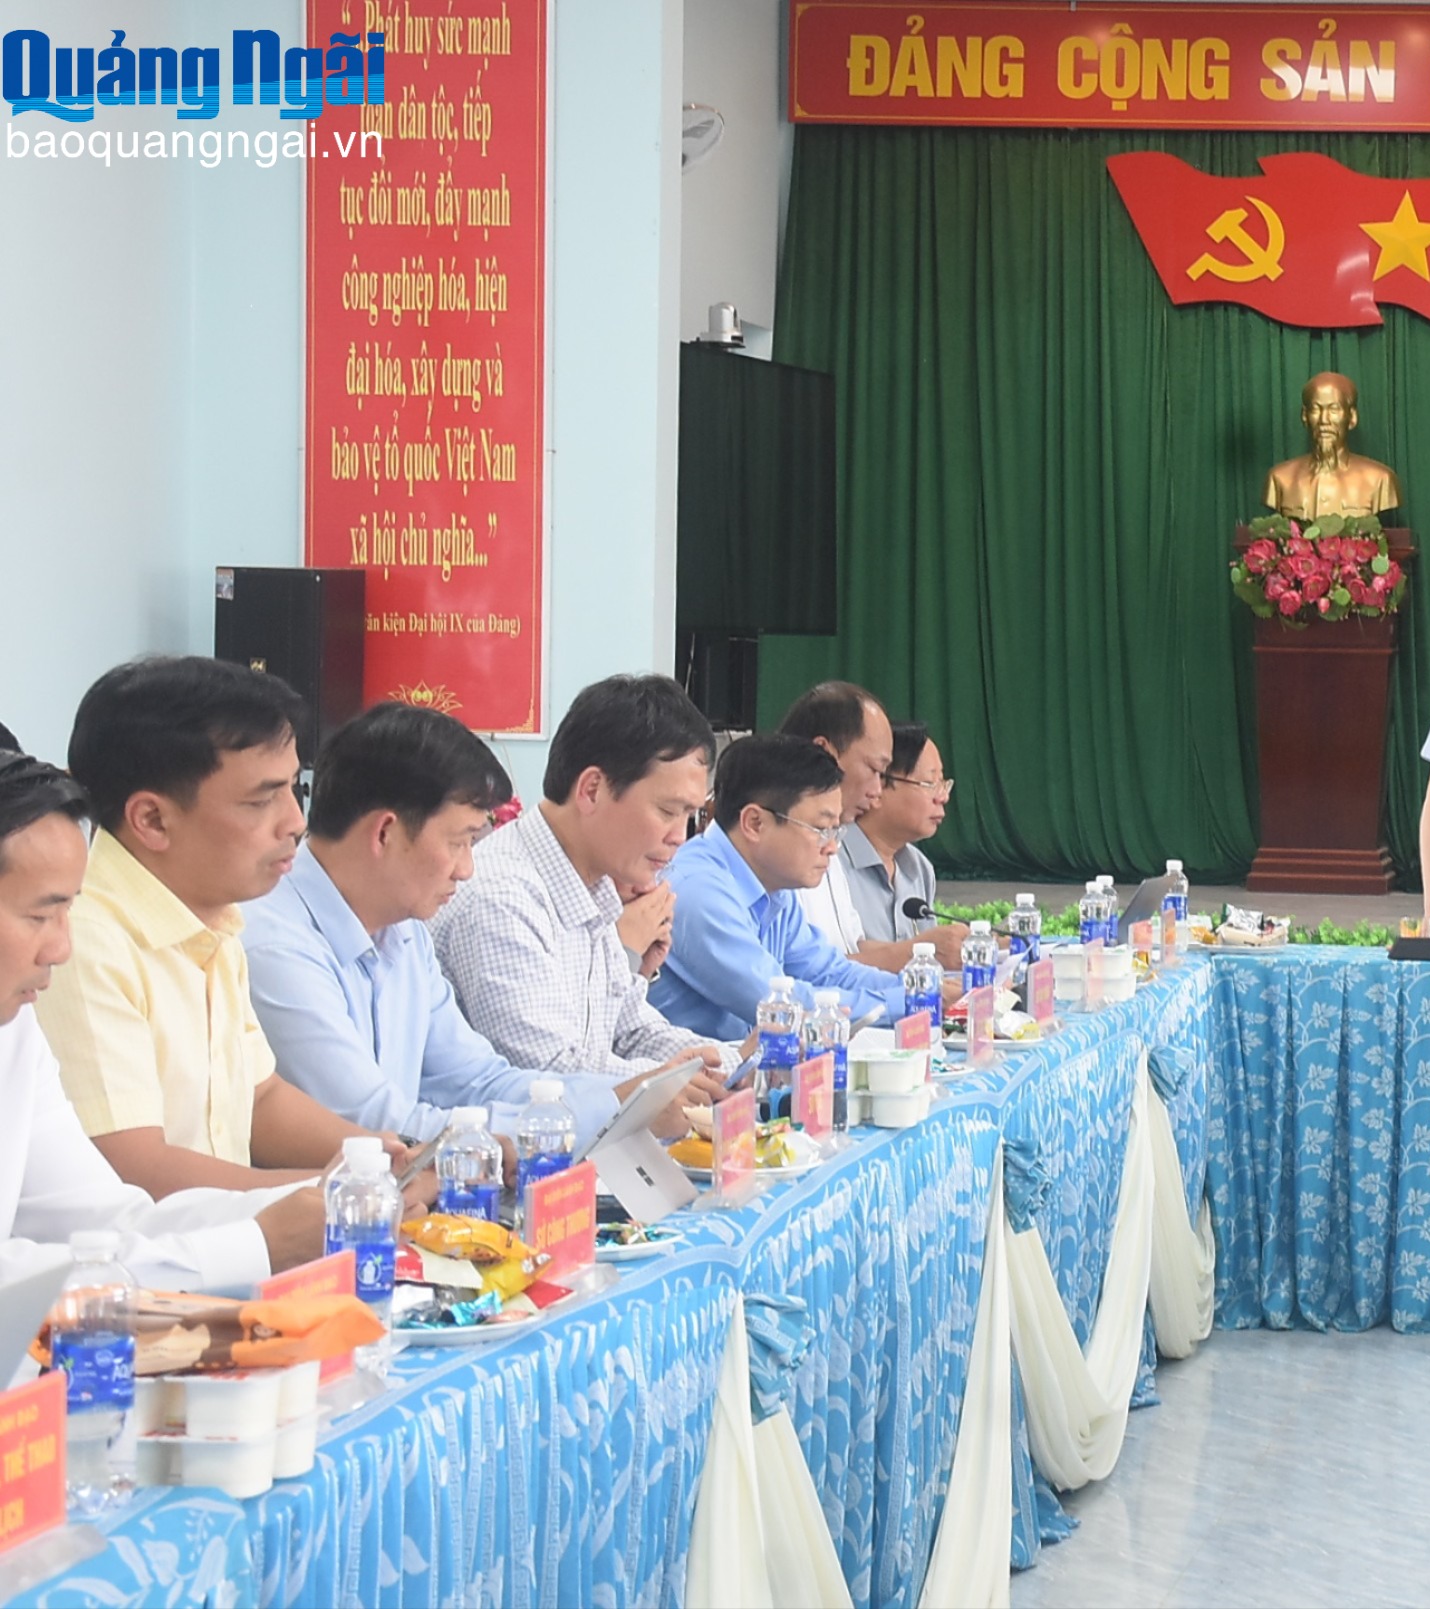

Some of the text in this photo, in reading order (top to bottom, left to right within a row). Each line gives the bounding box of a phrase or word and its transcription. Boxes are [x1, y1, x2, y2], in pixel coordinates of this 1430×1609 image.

[405, 0, 433, 70] huy
[437, 0, 463, 55] sức
[468, 0, 511, 70] mạnh
[847, 15, 1024, 98] ĐẢNG
[1057, 23, 1229, 111] CỘNG
[1260, 18, 1395, 103] SẢN
[399, 84, 426, 139] dân
[432, 84, 459, 155] tộc,
[463, 69, 492, 156] tiếp
[340, 154, 510, 241] tục đổi mới, đẩy mạnh
[342, 253, 507, 326] công nghiệp hóa, hiện
[346, 340, 503, 412] đại hóa, xây dựng và
[331, 410, 516, 497] bảo vệ tổ quốc Việt Nam
[350, 514, 367, 565] xã
[372, 510, 396, 581] hội
[400, 512, 428, 565] chủ
[383, 612, 405, 637] kiện
[409, 612, 427, 637] Đại
[430, 612, 447, 637] hội
[450, 613, 464, 632] IX
[466, 614, 485, 632] của
[488, 613, 521, 639] Đảng)
